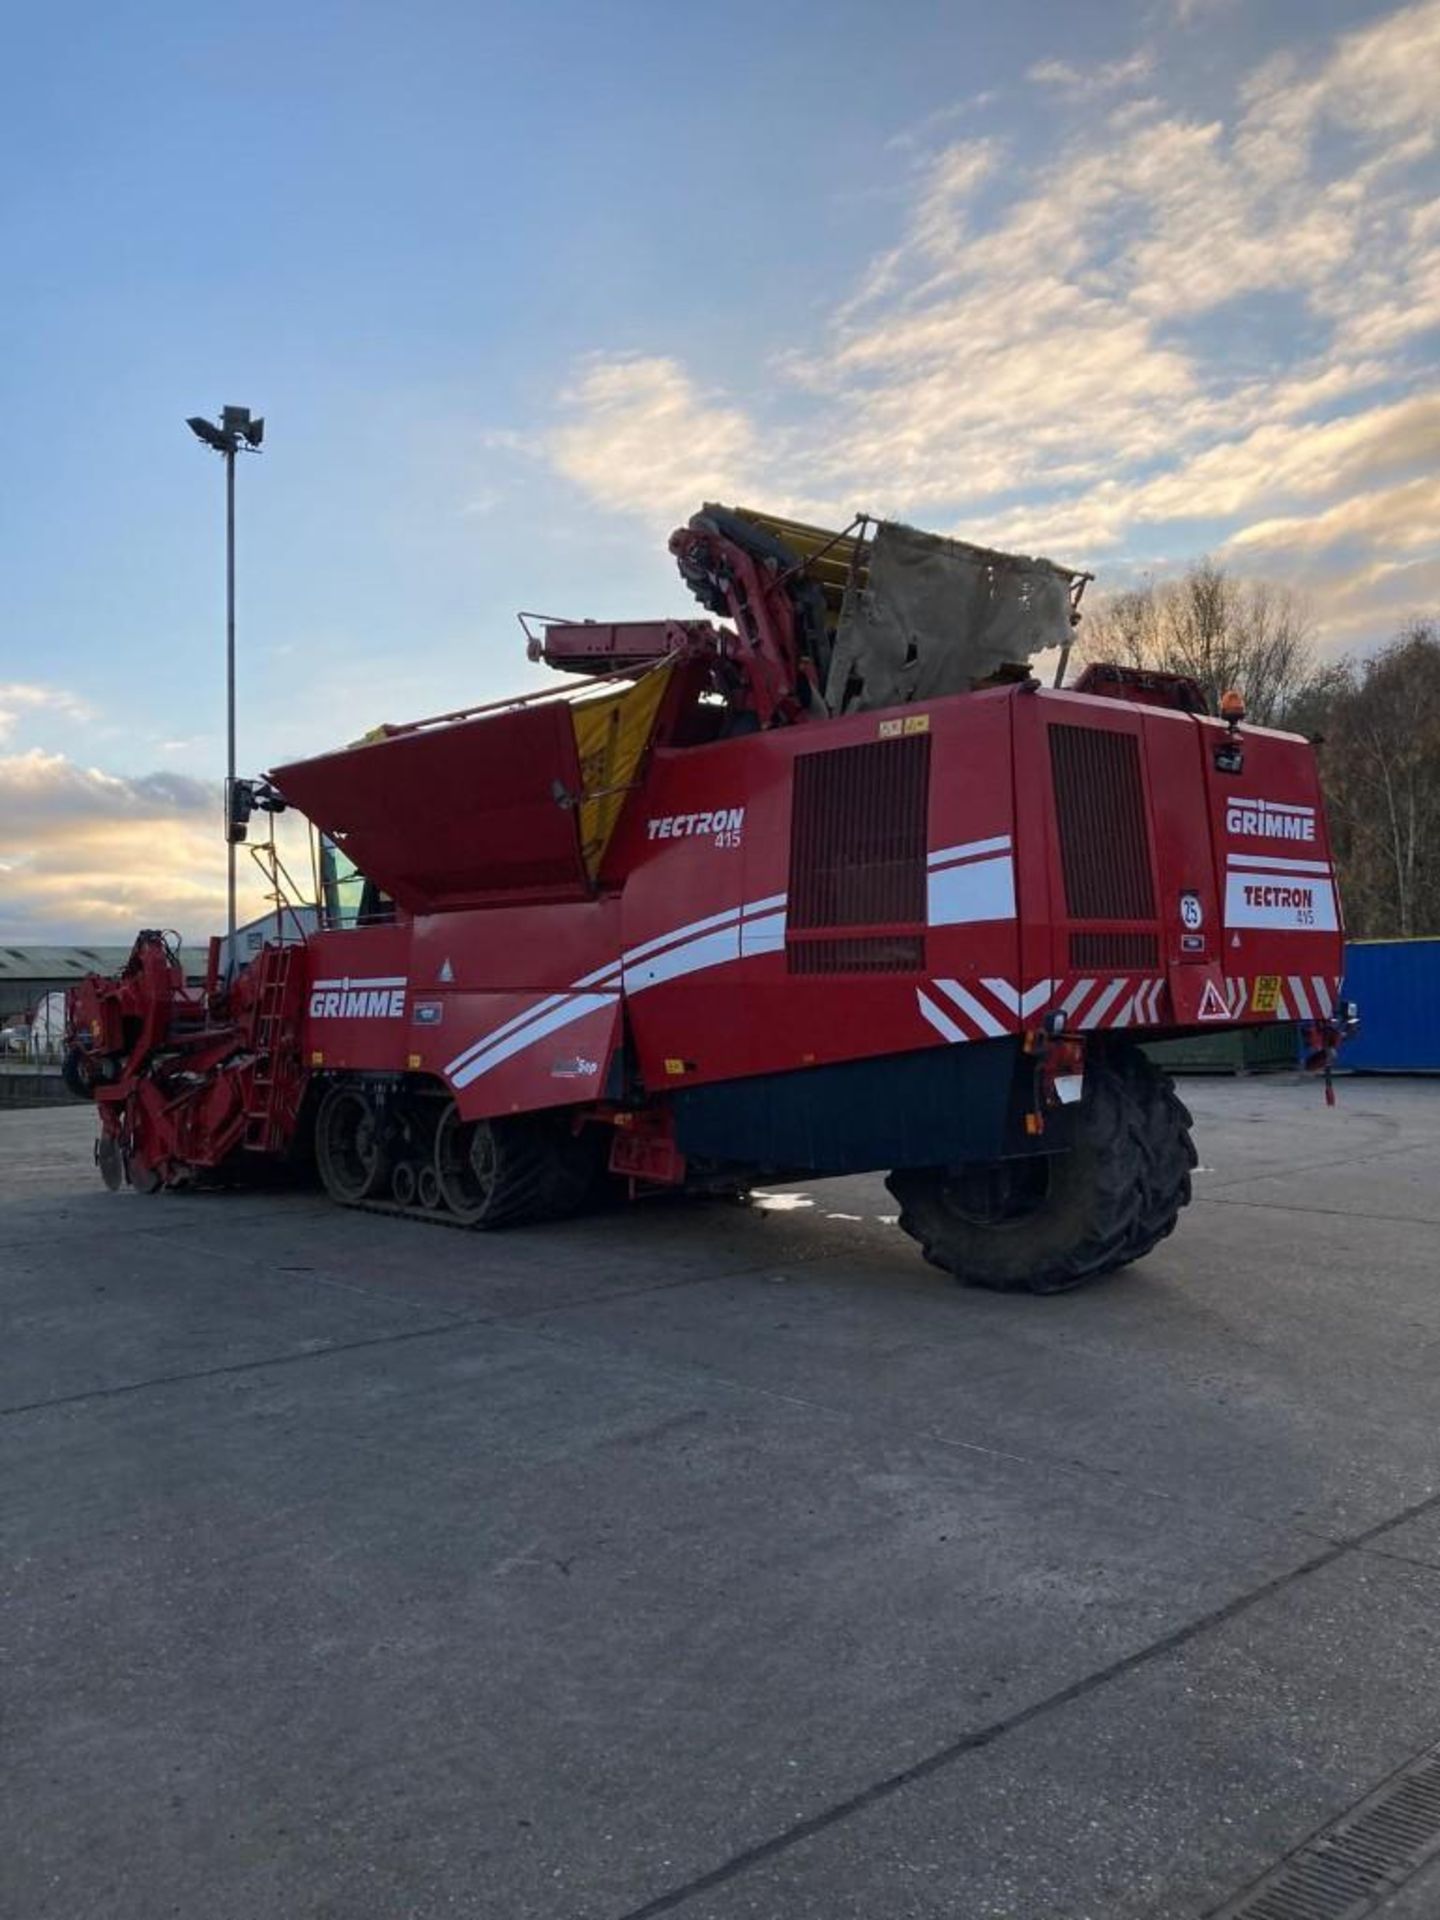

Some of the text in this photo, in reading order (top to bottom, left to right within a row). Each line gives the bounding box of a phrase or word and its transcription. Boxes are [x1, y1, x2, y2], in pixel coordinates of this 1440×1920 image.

[648, 807, 745, 840] TECTRON
[1226, 800, 1316, 842] GRIMME
[714, 830, 741, 848] 415
[1243, 885, 1313, 909] TECTRON
[1184, 900, 1198, 924] 25
[1296, 910, 1315, 925] 415
[309, 979, 406, 1018] GRIMME
